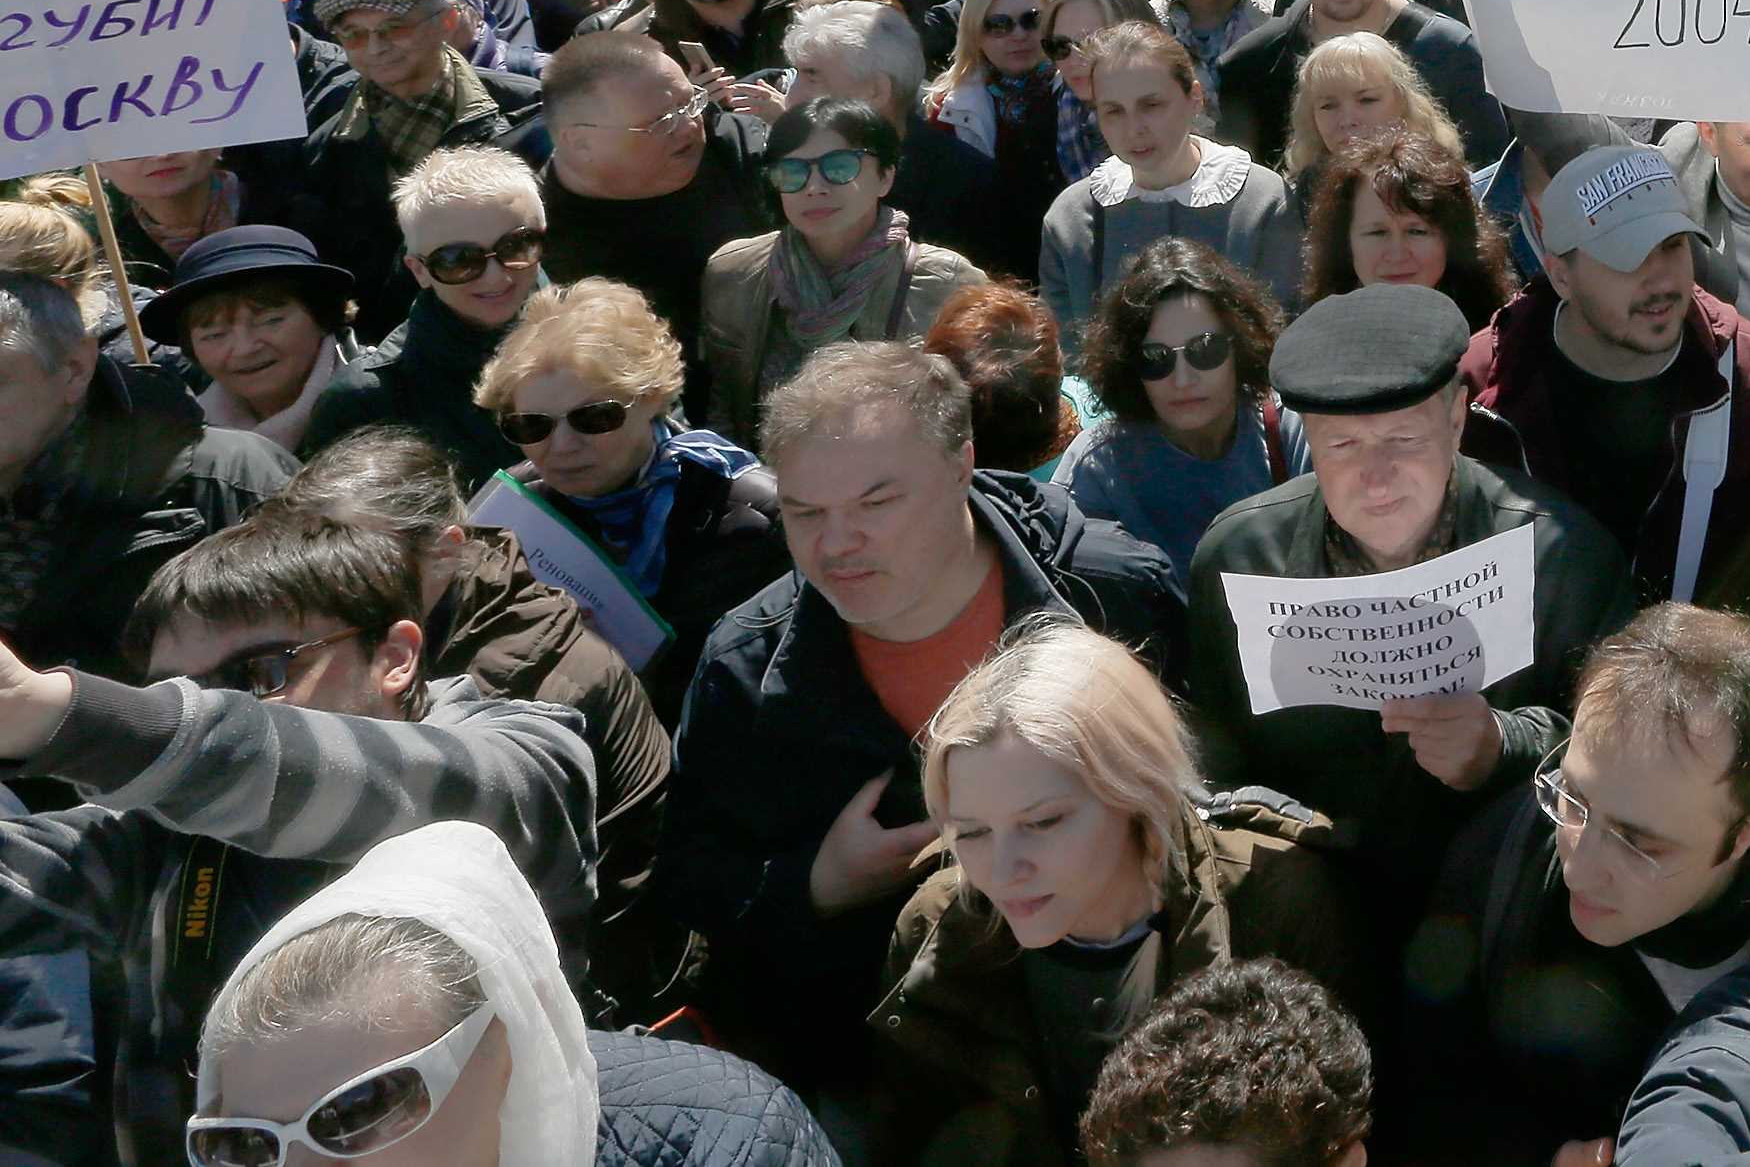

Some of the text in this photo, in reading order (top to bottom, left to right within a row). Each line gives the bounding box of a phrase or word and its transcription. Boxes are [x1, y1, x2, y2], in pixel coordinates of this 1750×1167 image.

[3, 54, 265, 141] ОСКВУ
[1576, 174, 1610, 213] SAN
[1267, 560, 1499, 620] ПРАВО ЧАСТНОЙ
[1267, 584, 1505, 643] СОБСТВЕННОСТИ
[1307, 644, 1482, 686] ОХРАНЯТЬСЯ
[1331, 635, 1454, 666] ДОЛЖНО
[184, 865, 214, 939] Nikon
